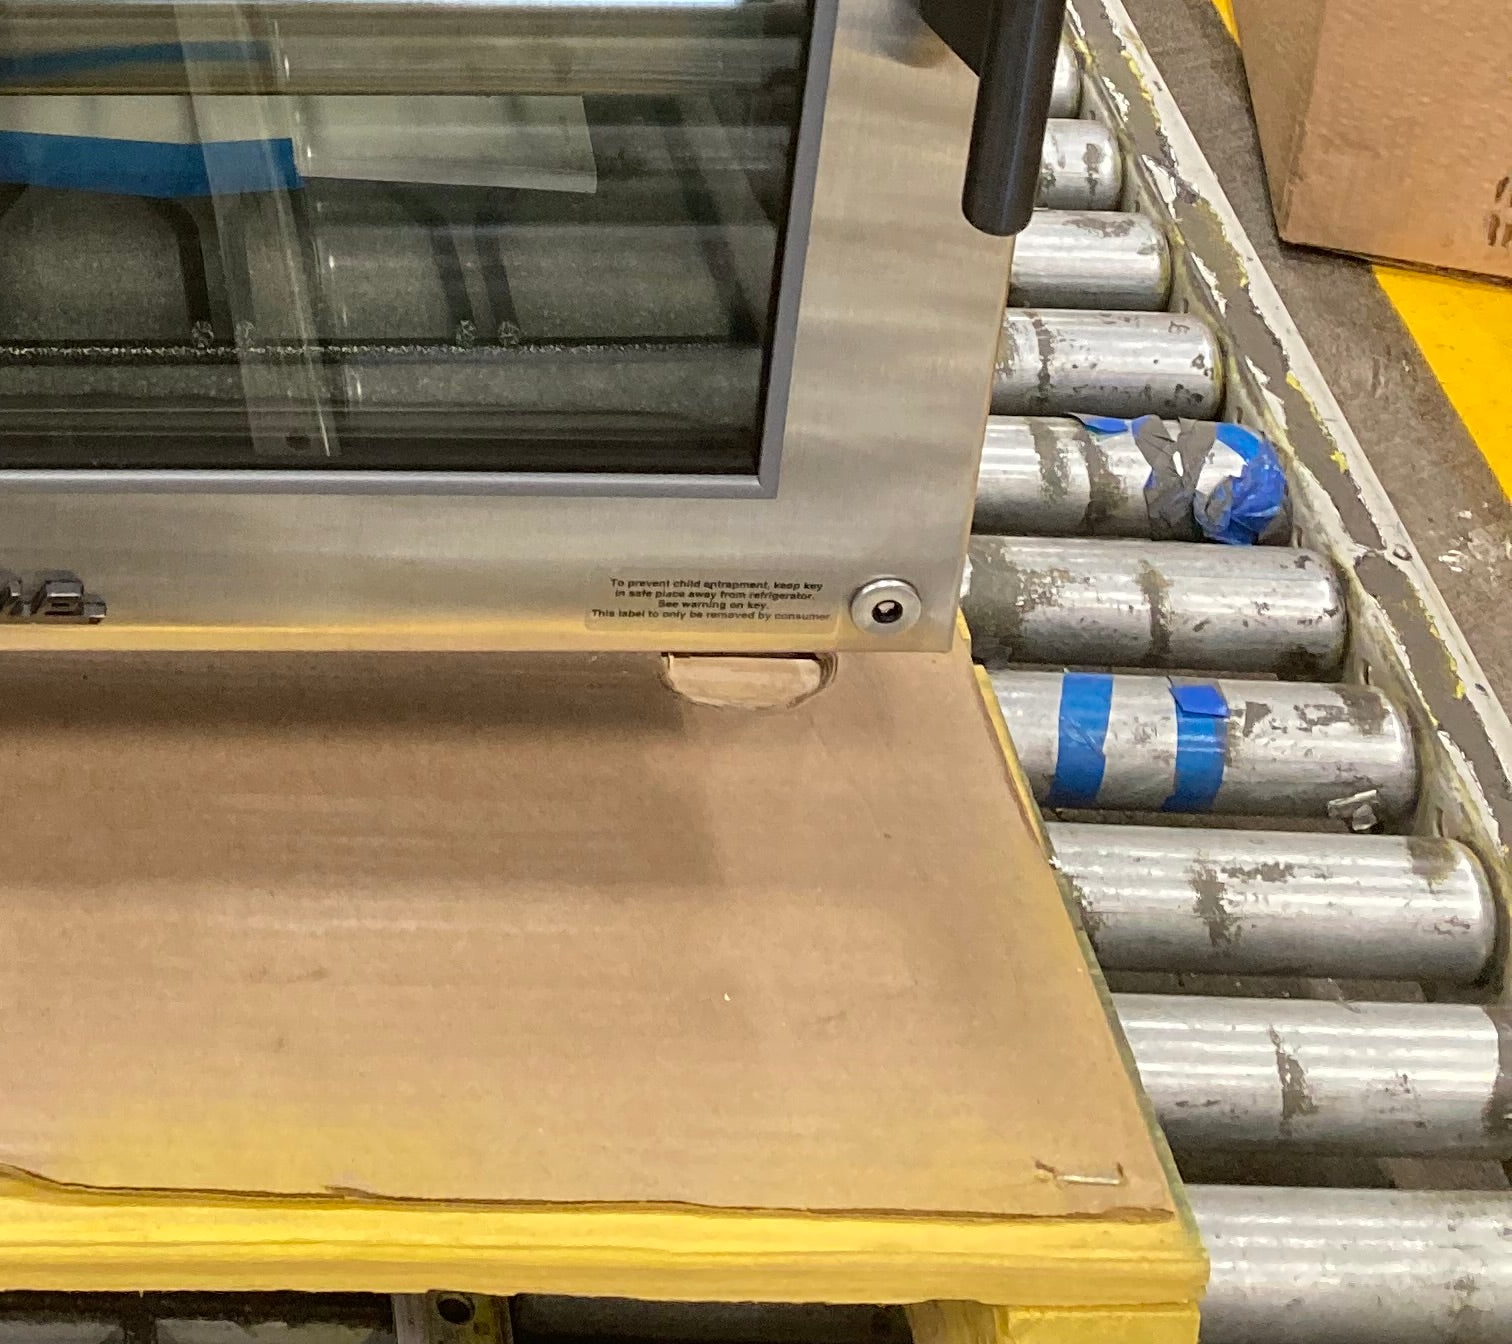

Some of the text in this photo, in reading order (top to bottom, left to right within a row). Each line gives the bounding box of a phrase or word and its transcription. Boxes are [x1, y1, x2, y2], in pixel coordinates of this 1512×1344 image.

[628, 579, 670, 589] prevent
[674, 578, 701, 589] child
[804, 582, 823, 591] key
[688, 591, 717, 601] away
[720, 591, 746, 599] from
[682, 601, 727, 611] warning
